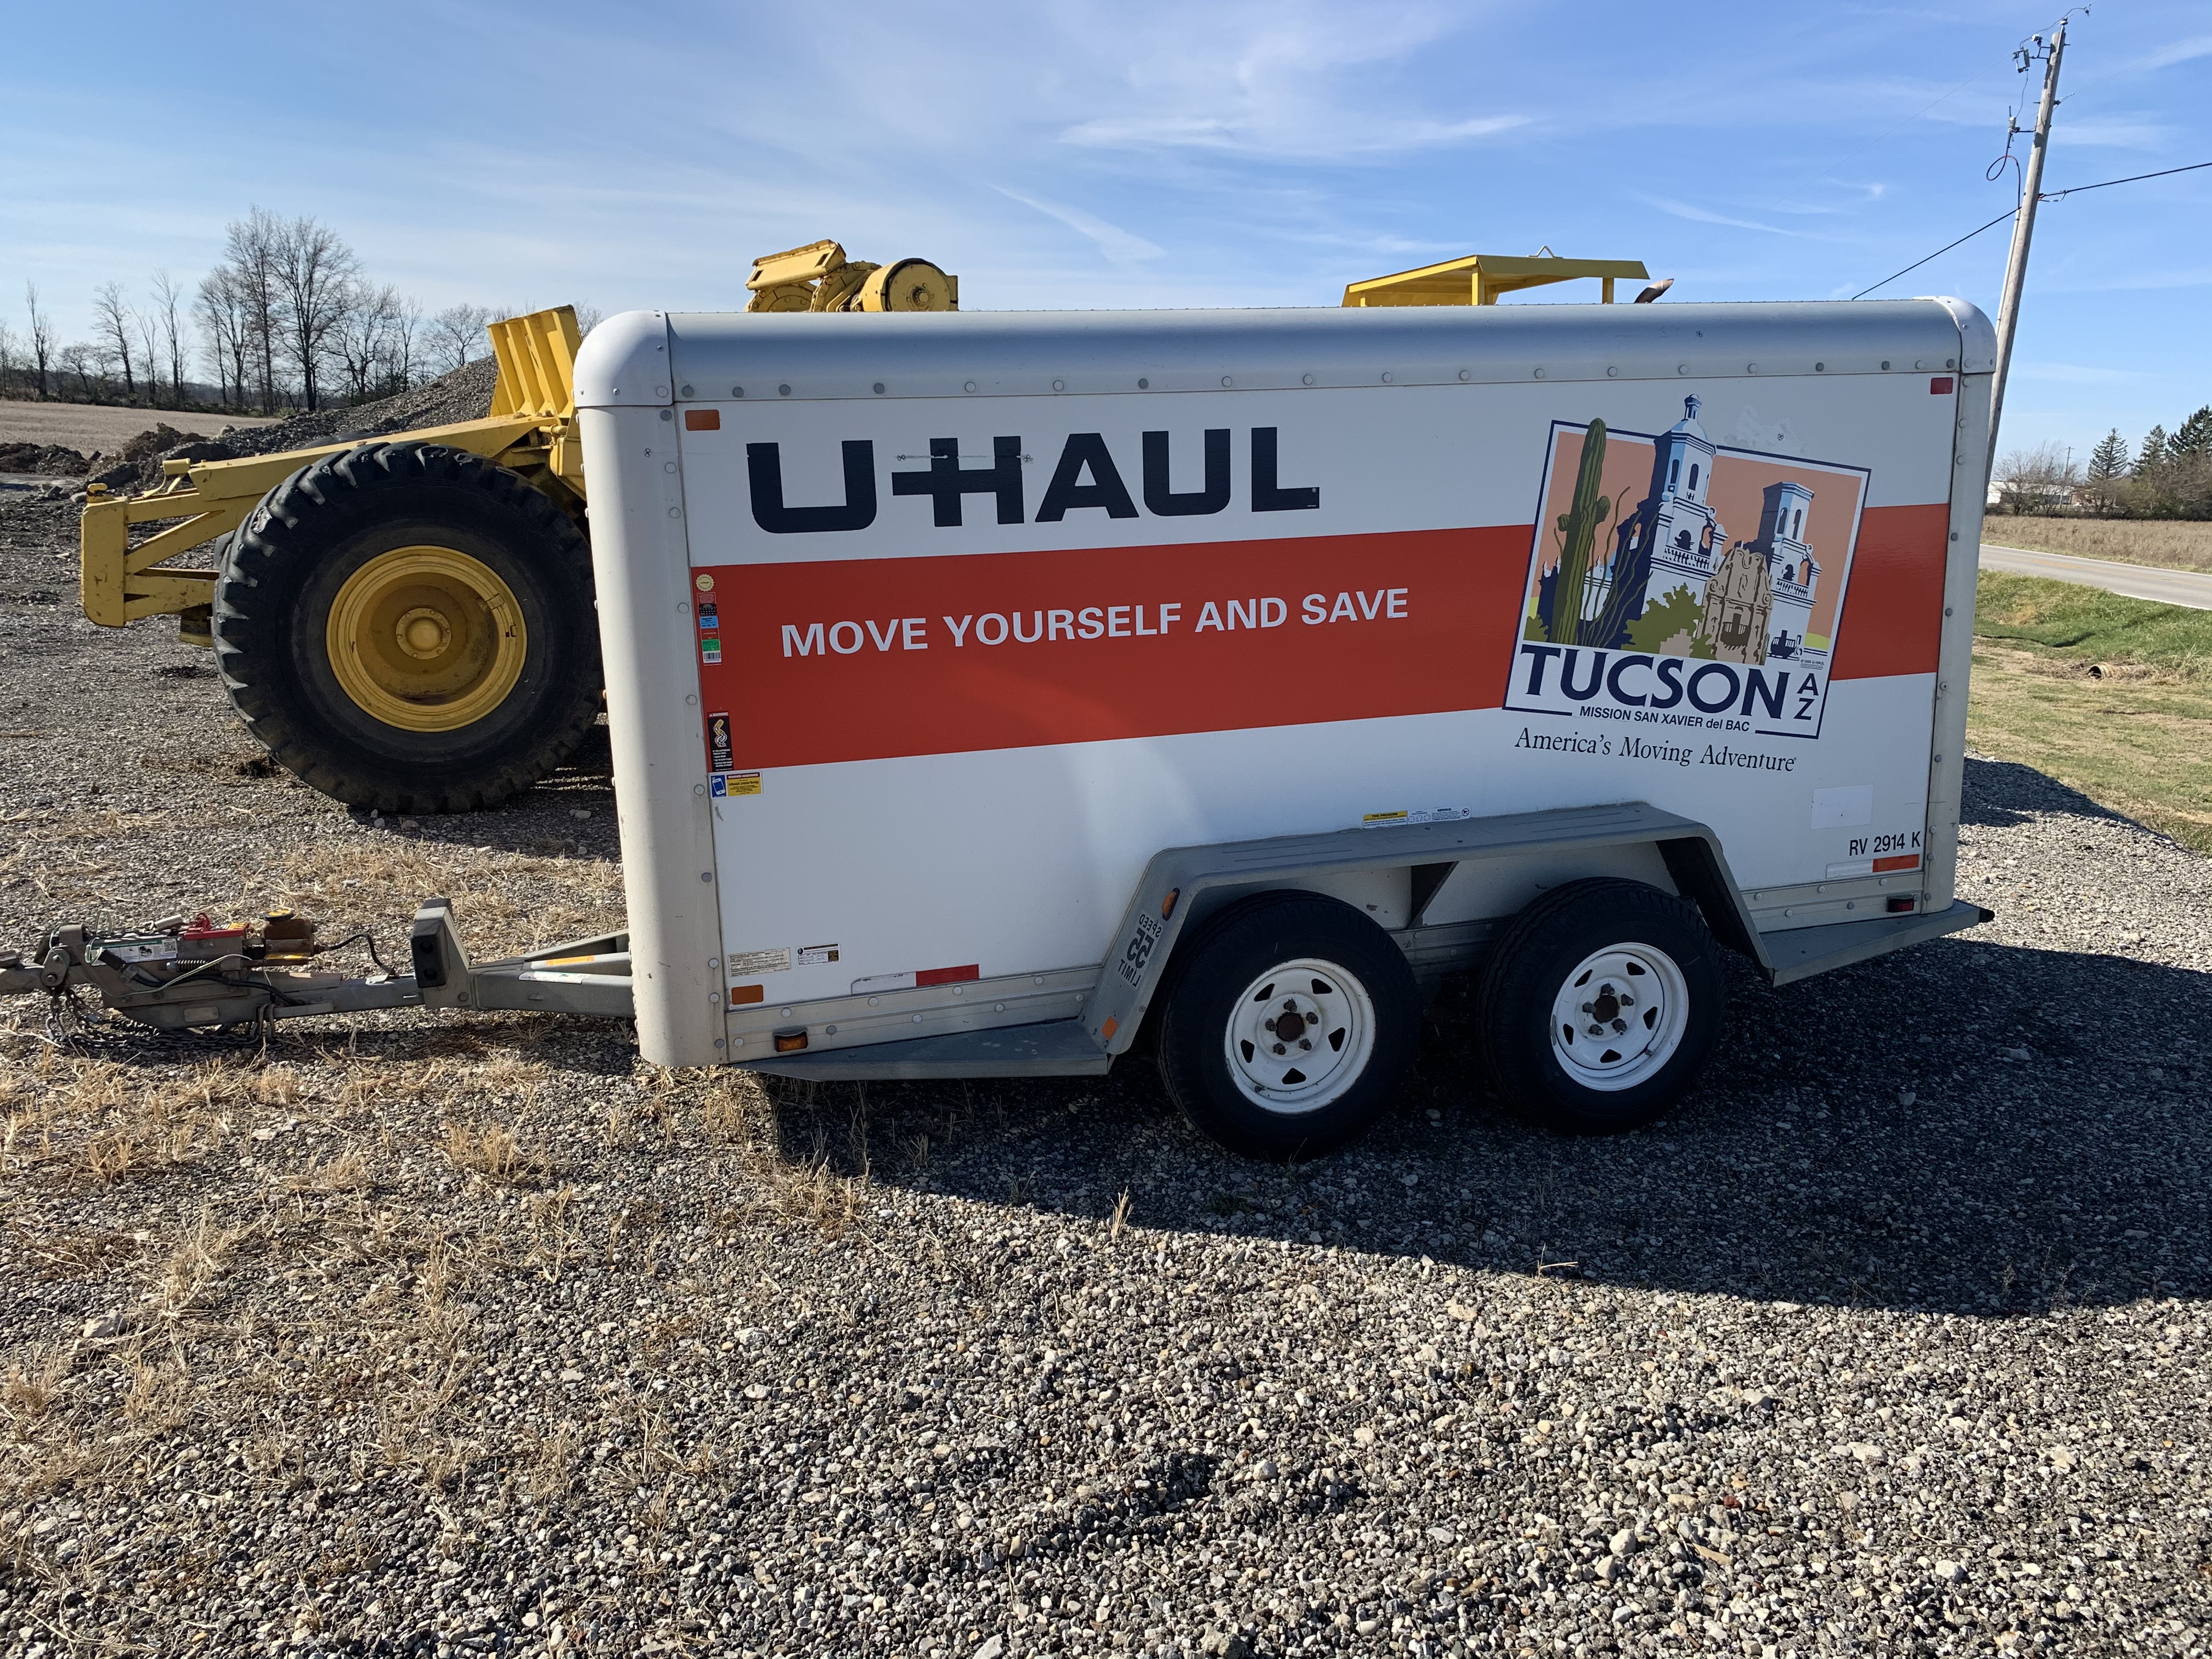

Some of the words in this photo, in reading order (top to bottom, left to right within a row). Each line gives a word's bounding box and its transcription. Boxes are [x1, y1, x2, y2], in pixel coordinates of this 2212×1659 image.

[746, 427, 1320, 533] U-HAUL
[782, 618, 928, 657] MOVE
[943, 603, 1181, 647] YOURSELF
[1195, 597, 1288, 633] AND
[1302, 588, 1408, 625] SAVE
[1520, 644, 1790, 720] TUCSON
[1579, 706, 1632, 720] MISSION
[1634, 710, 1659, 723] SAN
[1661, 714, 1703, 727] XAVIER
[1706, 718, 1723, 730] del
[1725, 720, 1750, 732] BAC
[1514, 727, 1611, 755] America's
[1619, 736, 1693, 767] Moving
[1700, 744, 1795, 772] Adventure
[1849, 838, 1869, 856] RV
[1874, 833, 1905, 853] 2914
[1911, 831, 1921, 848] K
